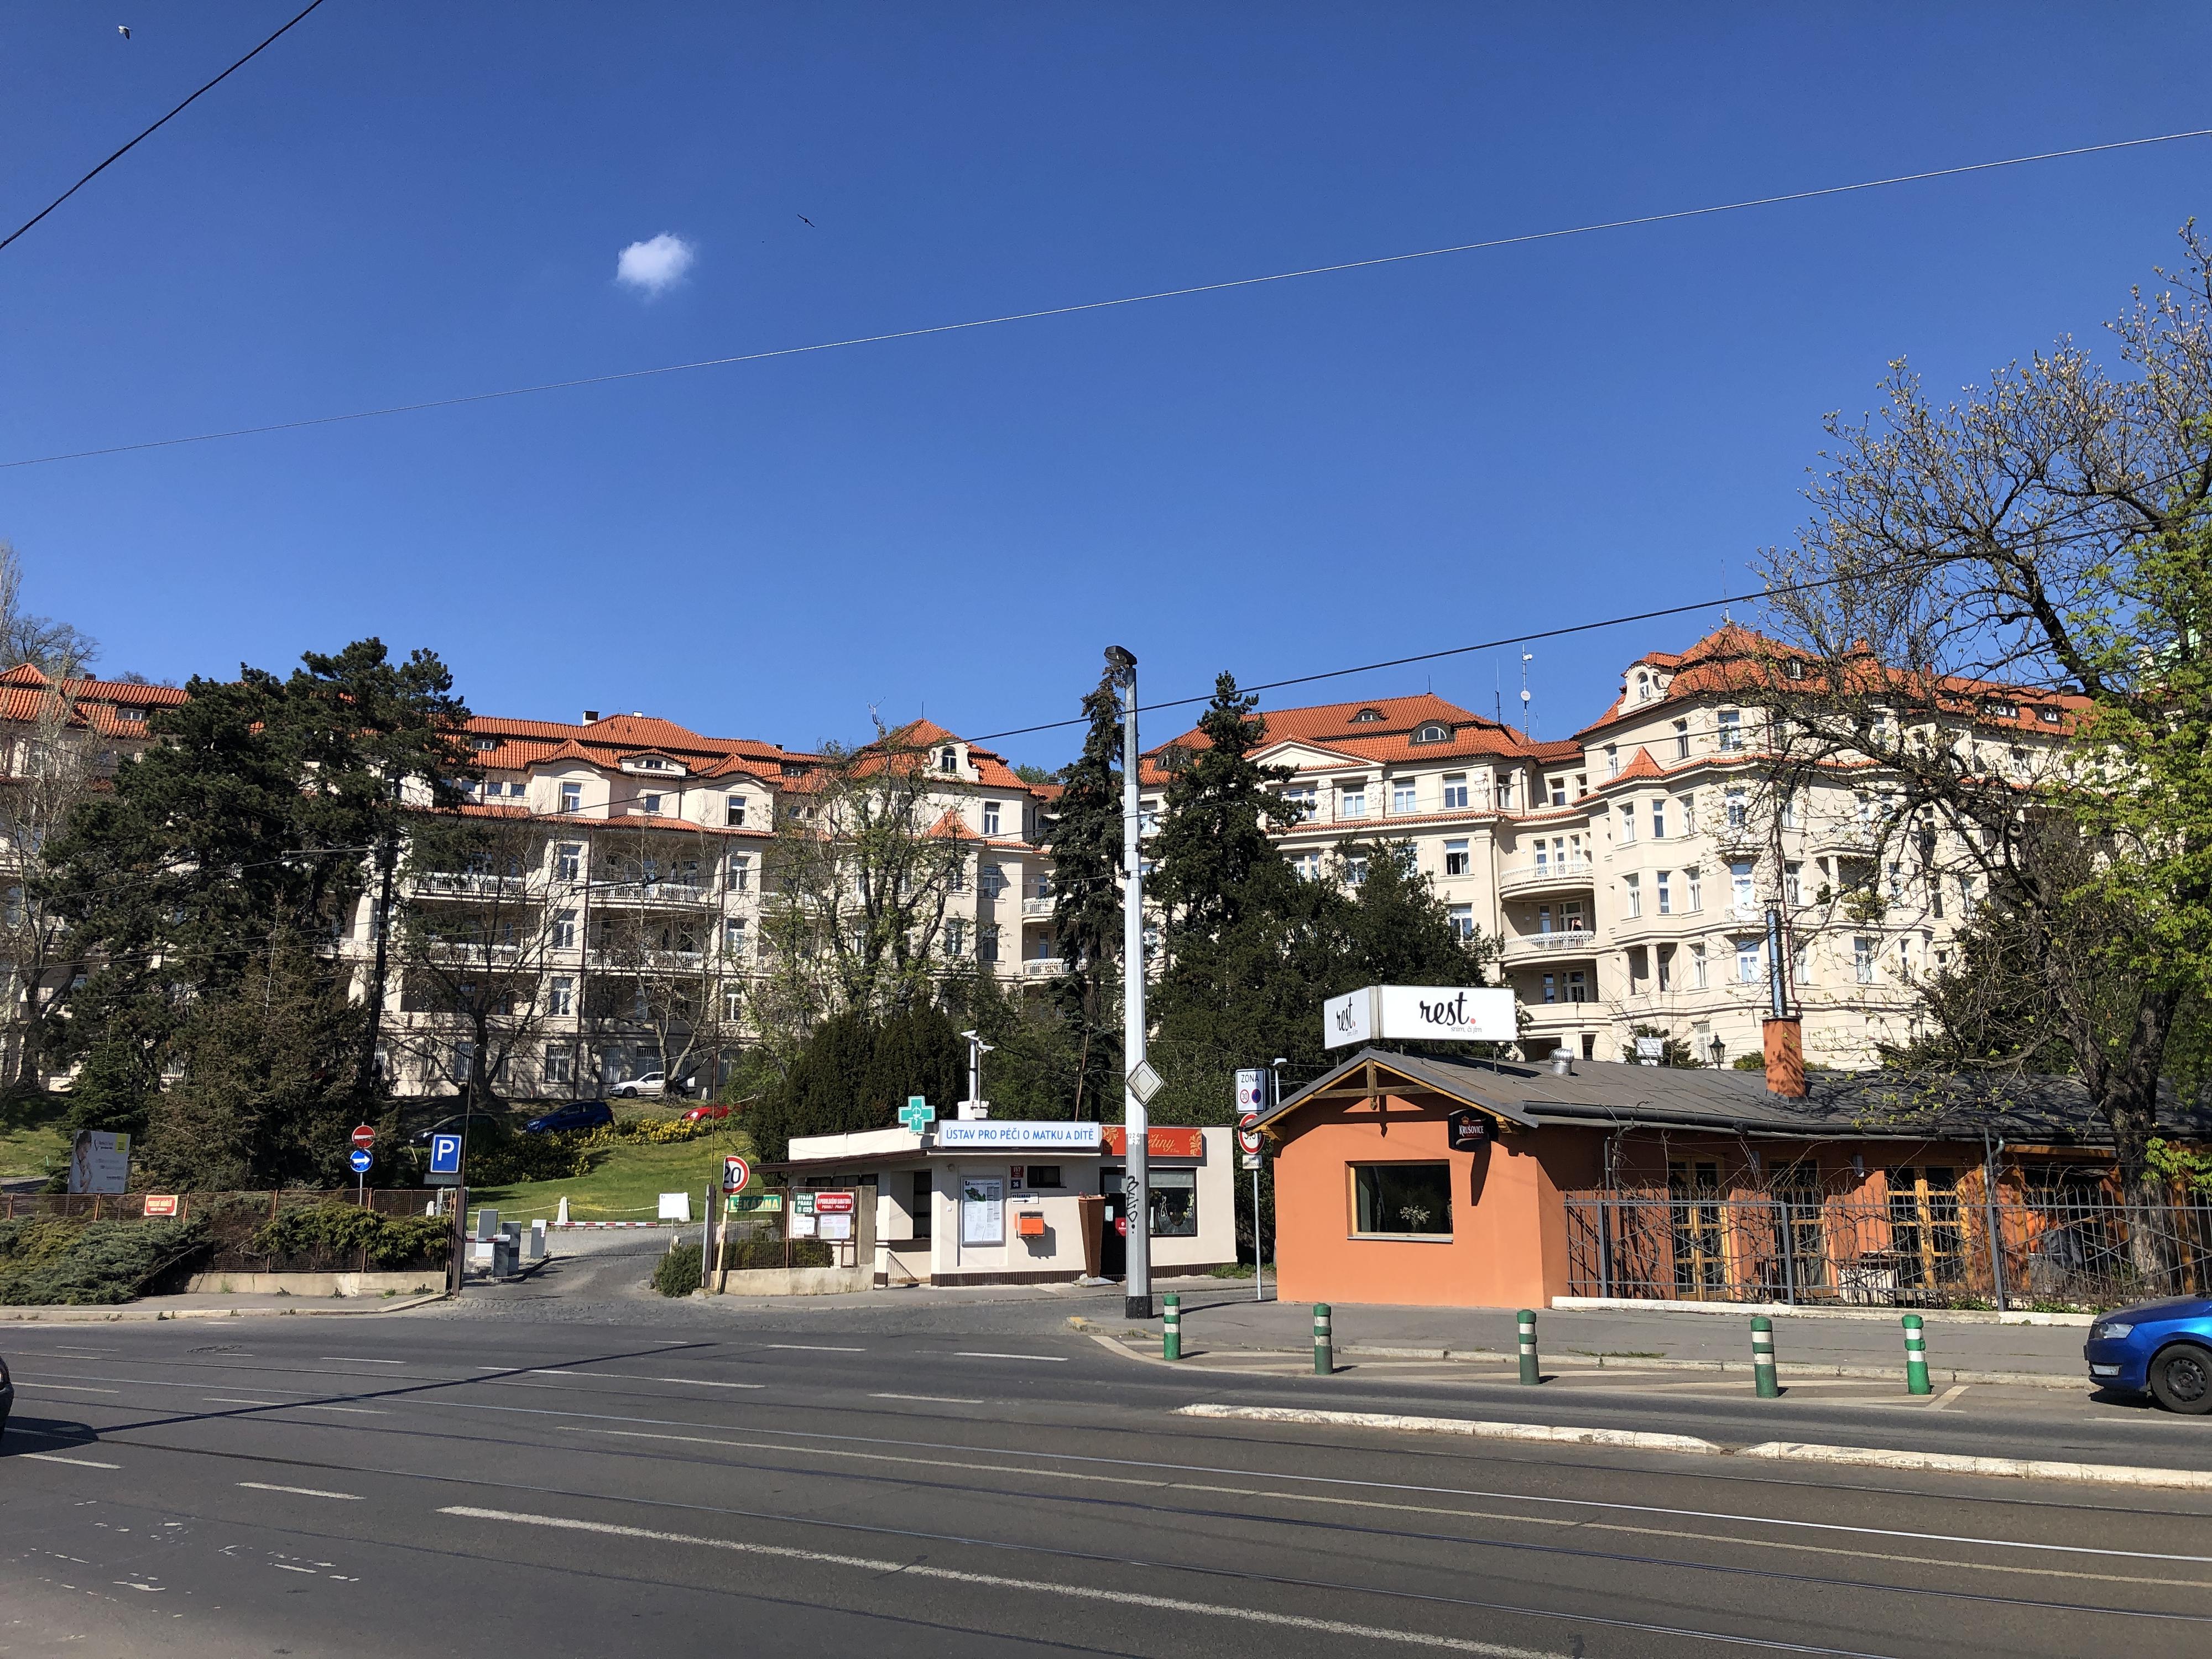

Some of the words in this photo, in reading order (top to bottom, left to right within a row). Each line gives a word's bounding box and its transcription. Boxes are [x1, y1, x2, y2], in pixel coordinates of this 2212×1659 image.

[1420, 992, 1476, 1026] rest.
[1241, 1072, 1259, 1083] ZÓNA
[946, 1127, 975, 1139] ÚSTAV
[978, 1130, 997, 1139] PRO
[1000, 1128, 1020, 1140] PÉČI
[1023, 1130, 1030, 1140] O
[1032, 1130, 1063, 1140] MATKU
[1065, 1130, 1072, 1140] A
[1074, 1128, 1094, 1140] DÍTĚ
[437, 1140, 455, 1161] P
[724, 1165, 742, 1184] 20
